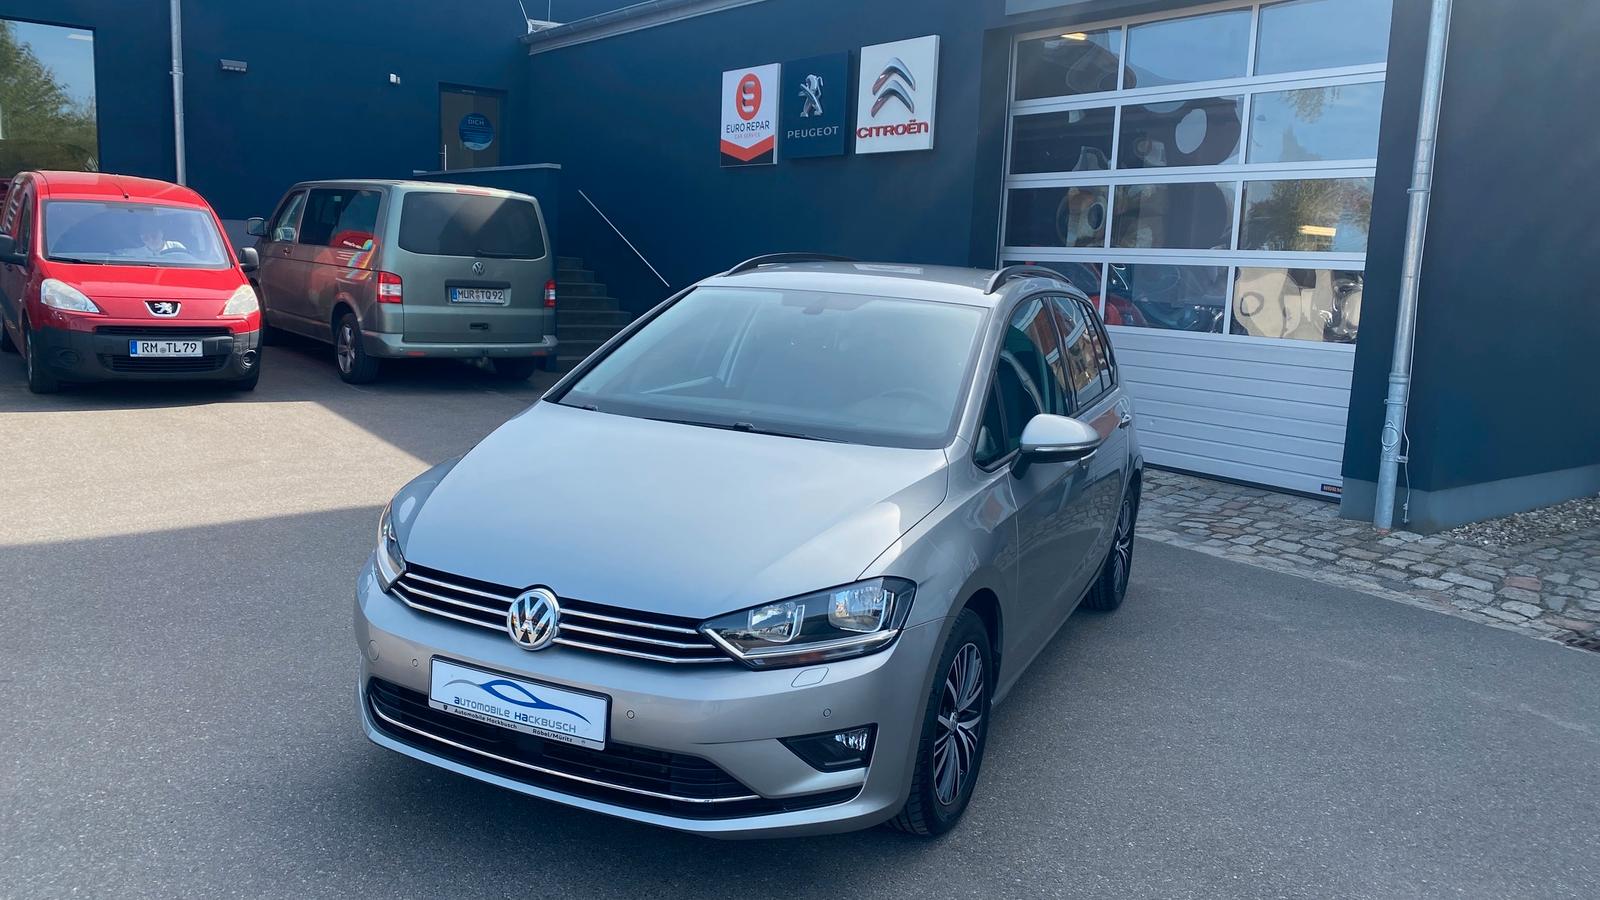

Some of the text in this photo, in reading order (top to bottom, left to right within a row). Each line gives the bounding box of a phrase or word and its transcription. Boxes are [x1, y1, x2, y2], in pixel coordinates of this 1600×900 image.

[726, 120, 770, 133] EURO REPAR
[787, 125, 839, 139] PEUGEOT
[857, 119, 929, 138] CITROËN
[142, 342, 197, 353] RM TL 79
[454, 708, 486, 721] Automobile
[486, 716, 518, 729] Hackbusch
